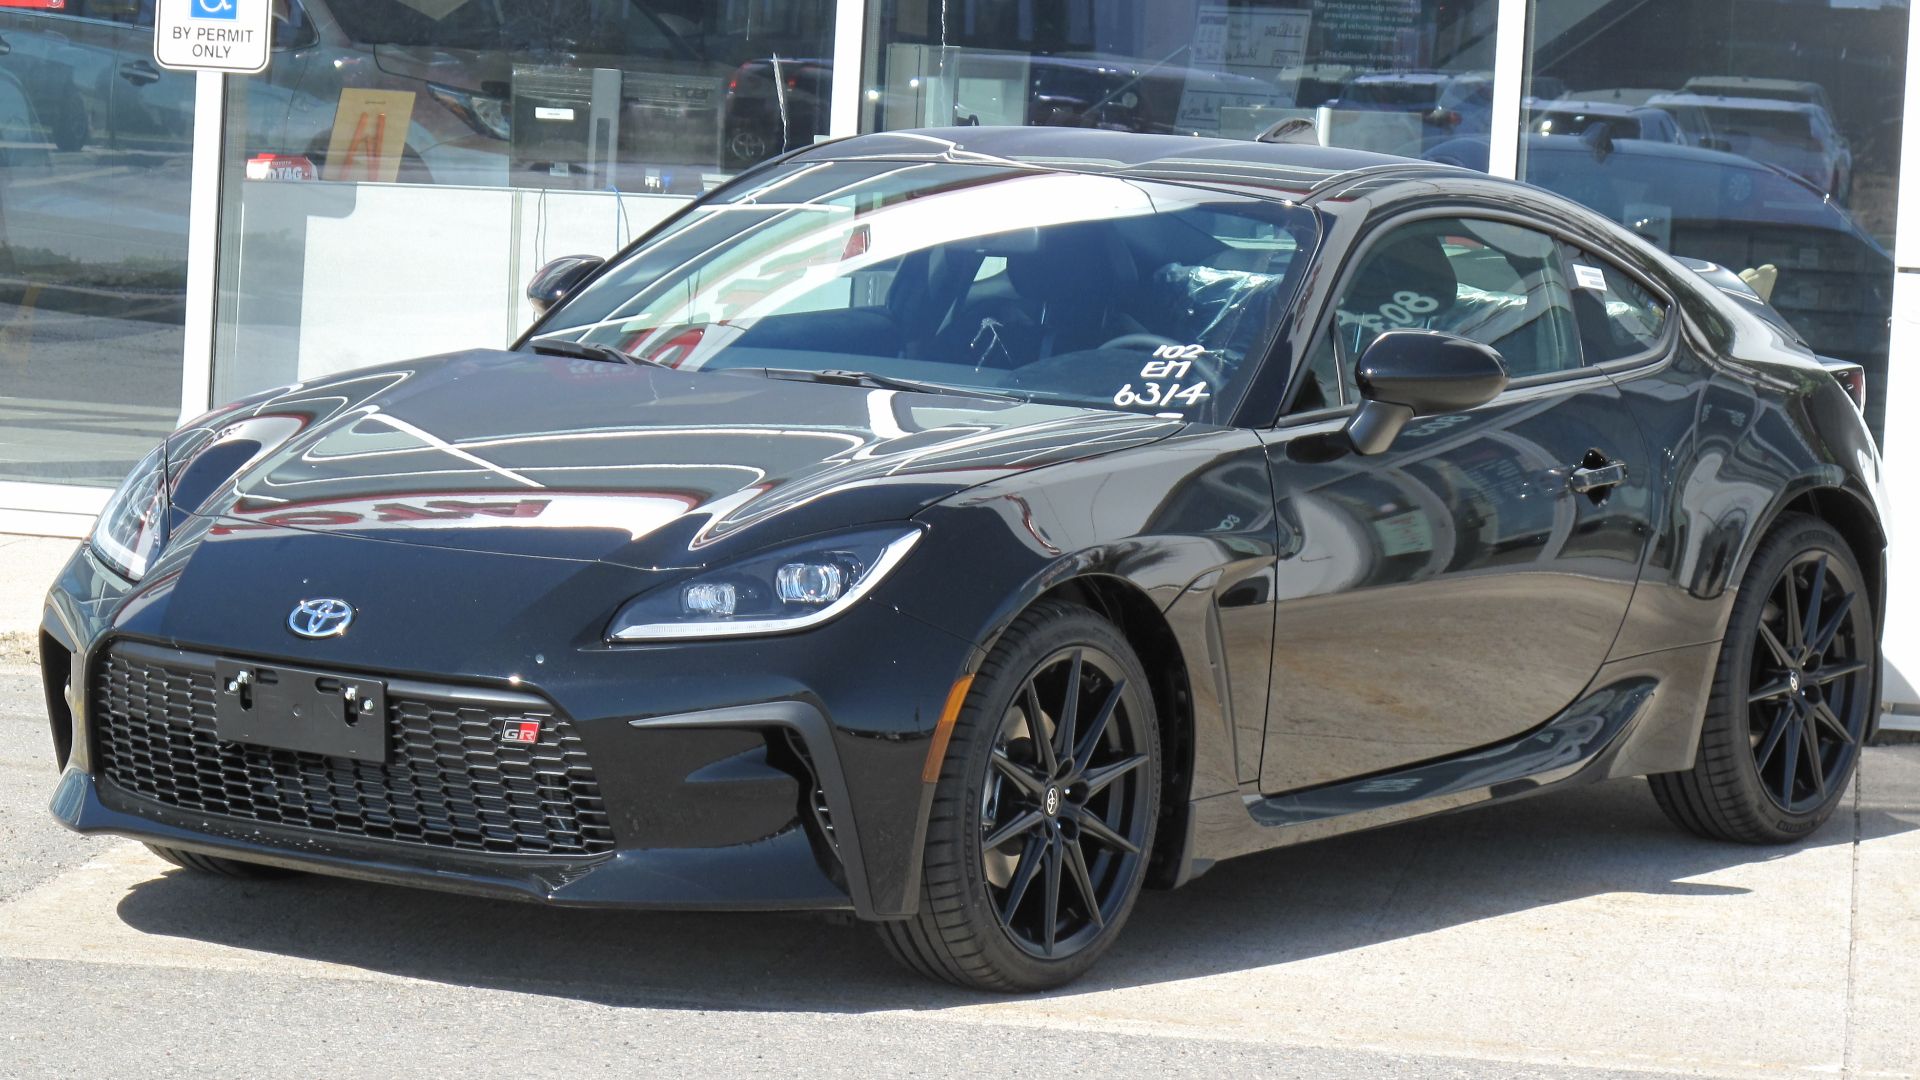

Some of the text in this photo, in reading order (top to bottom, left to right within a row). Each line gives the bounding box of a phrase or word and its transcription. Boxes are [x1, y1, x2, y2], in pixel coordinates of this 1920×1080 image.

[172, 26, 253, 43] BY PERMIT
[192, 44, 232, 59] ONLY
[1153, 343, 1206, 359] 102
[1140, 360, 1192, 379] EM
[504, 729, 535, 741] GR
